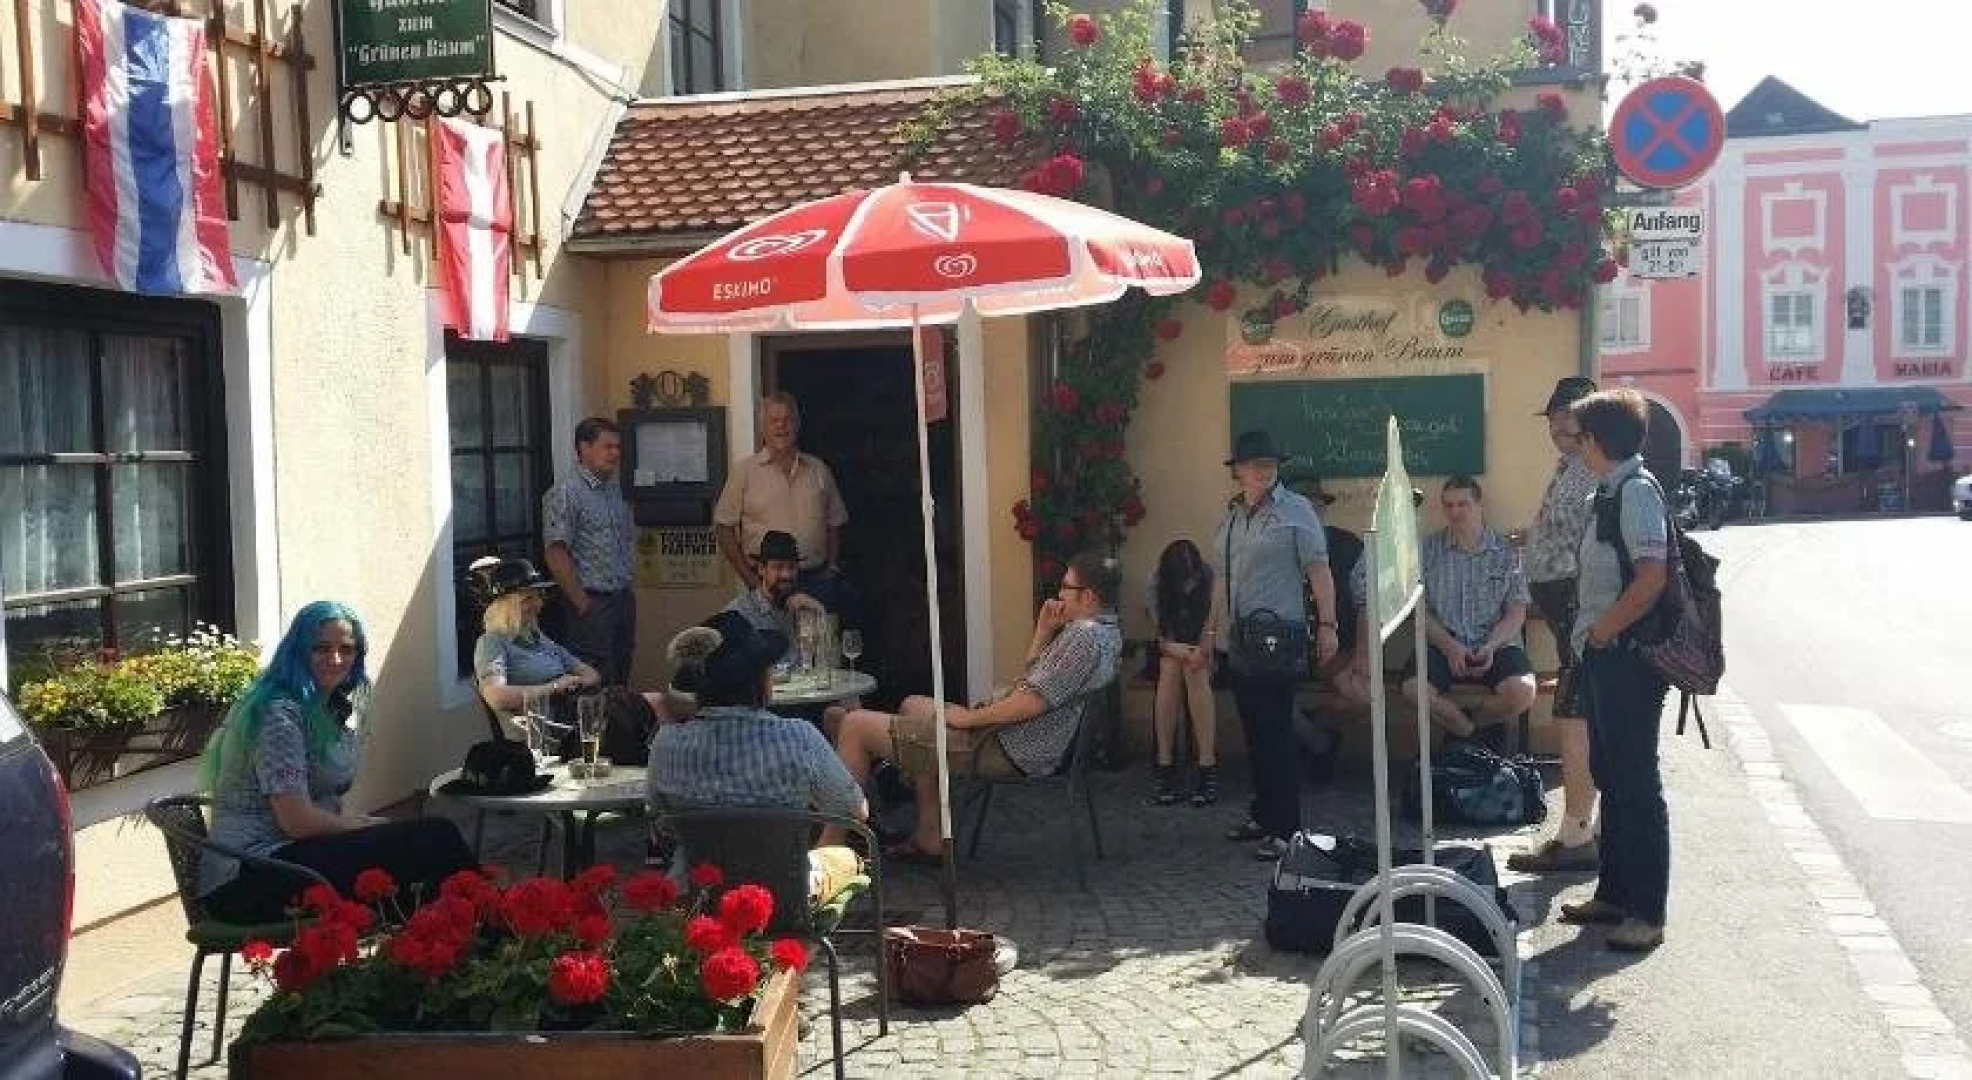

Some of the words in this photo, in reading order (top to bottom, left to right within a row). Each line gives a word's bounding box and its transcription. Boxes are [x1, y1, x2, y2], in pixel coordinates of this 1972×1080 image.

[398, 16, 433, 31] zum
[1633, 210, 1700, 233] Anfang
[712, 278, 771, 300] ESKIMO
[659, 531, 717, 544] TOURING
[660, 544, 717, 555] PARTNER
